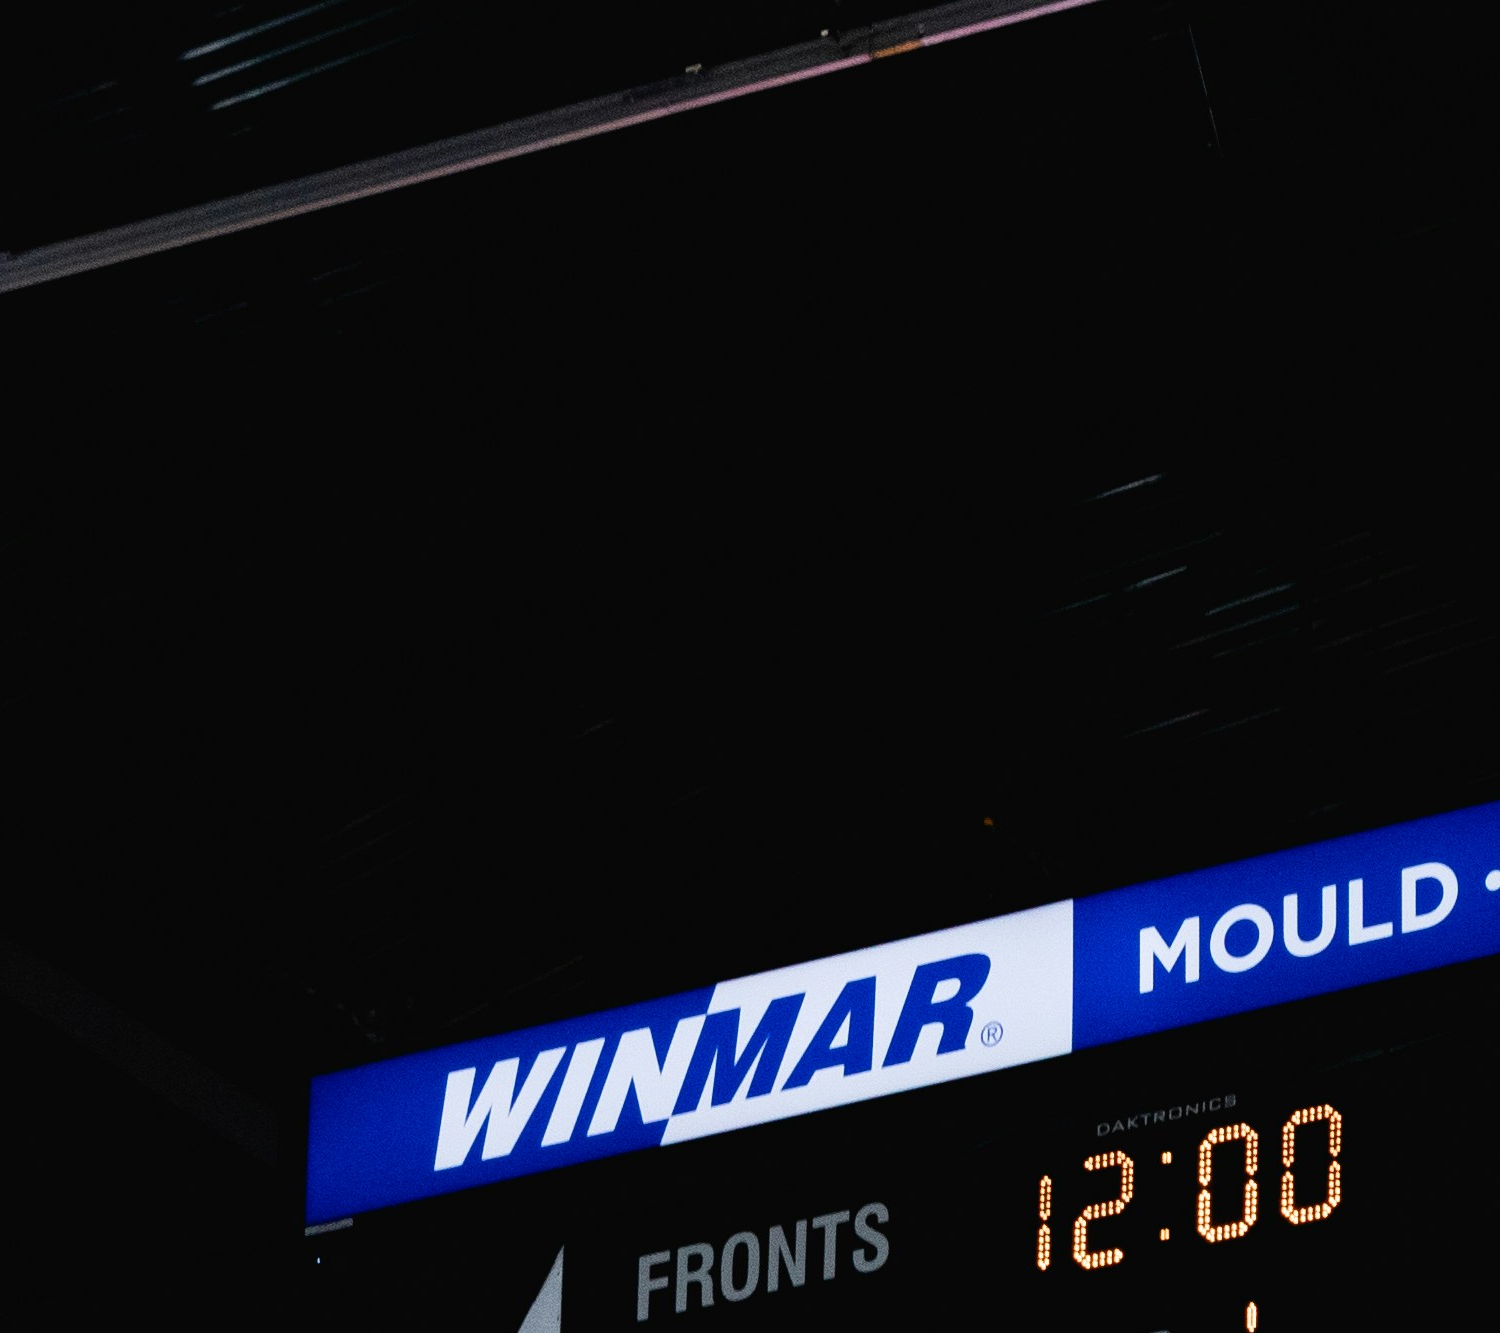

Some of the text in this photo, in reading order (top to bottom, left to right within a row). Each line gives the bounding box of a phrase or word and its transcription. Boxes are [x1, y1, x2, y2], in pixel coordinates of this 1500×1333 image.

[1139, 862, 1459, 995] MOULD
[1097, 1093, 1238, 1137] DAKTRONICS
[1036, 1103, 1343, 1272] 12:00
[636, 1202, 891, 1322] FRONTS
